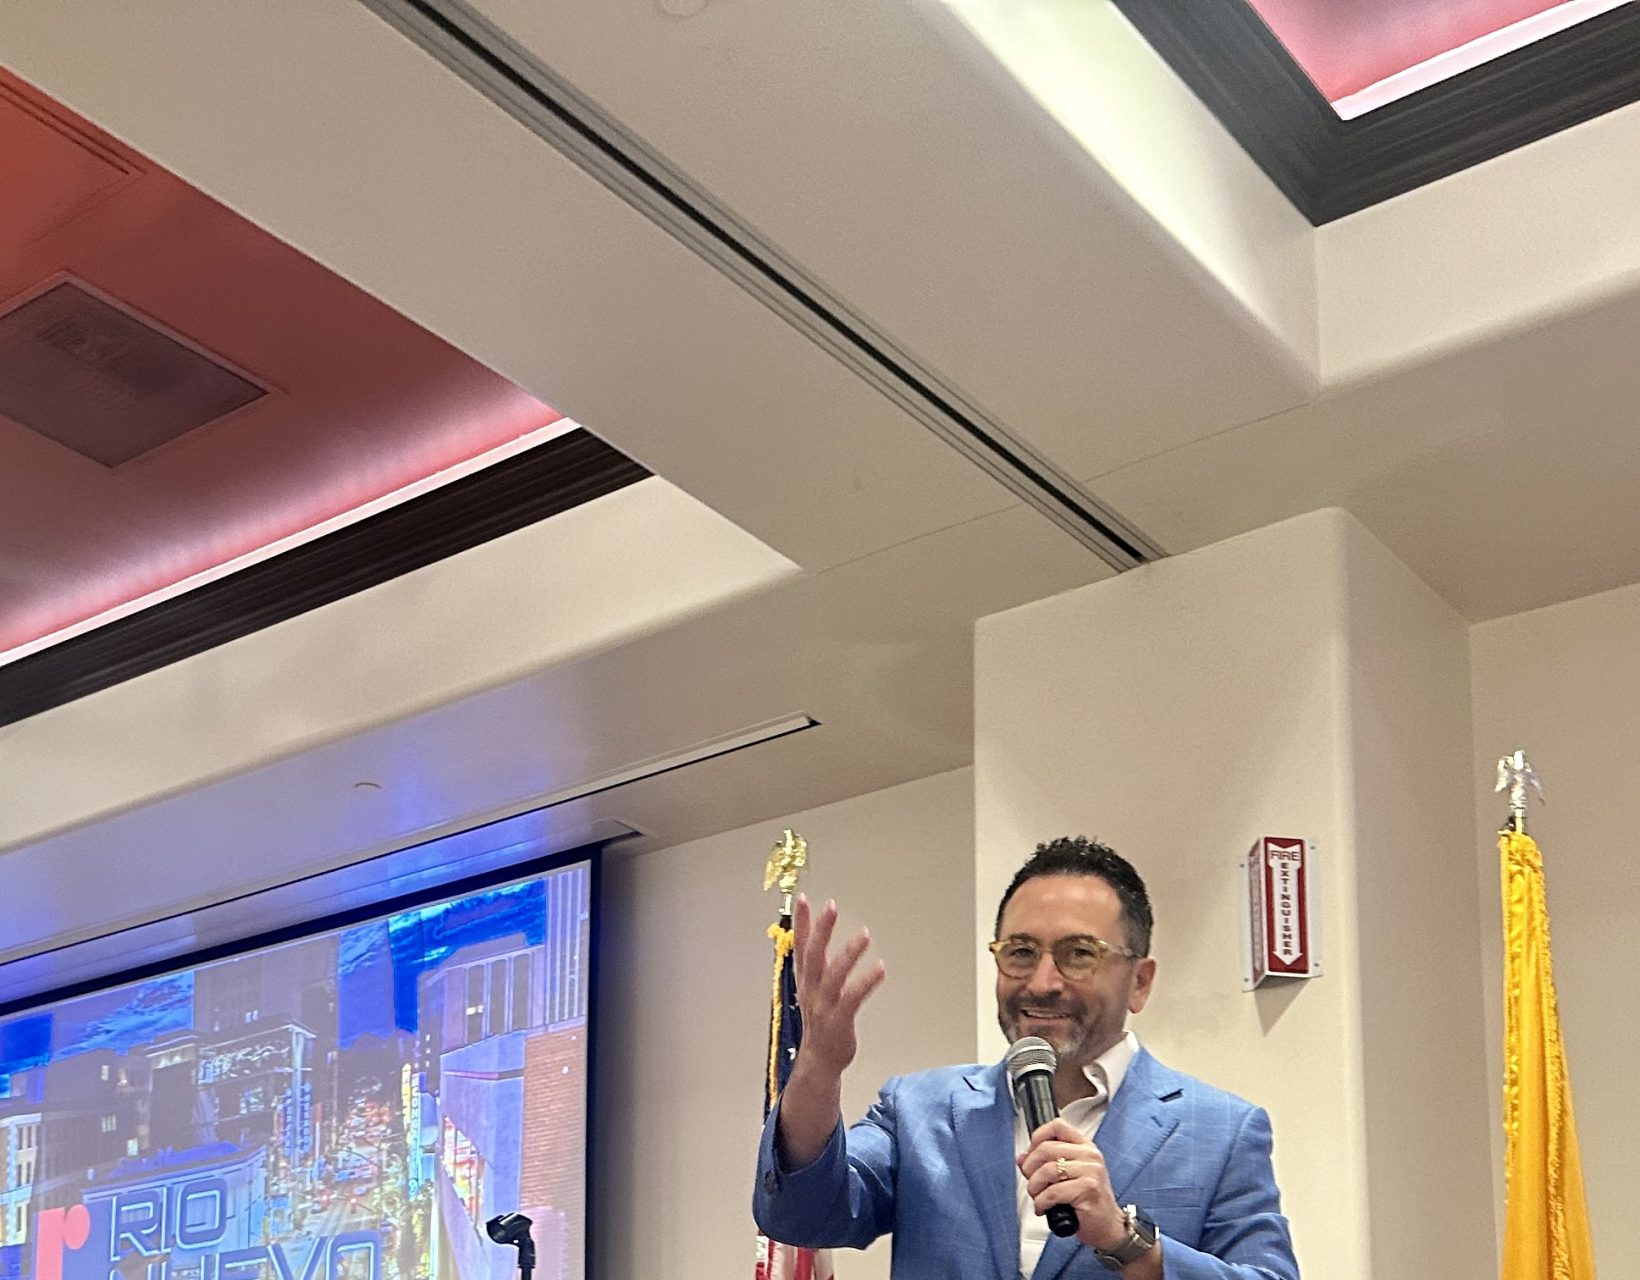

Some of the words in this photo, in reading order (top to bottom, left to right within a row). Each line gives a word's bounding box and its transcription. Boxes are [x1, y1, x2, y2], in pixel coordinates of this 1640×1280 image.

[1270, 850, 1300, 861] FIRE
[1281, 862, 1293, 956] EXTINGUISHER
[110, 1178, 228, 1262] RIO
